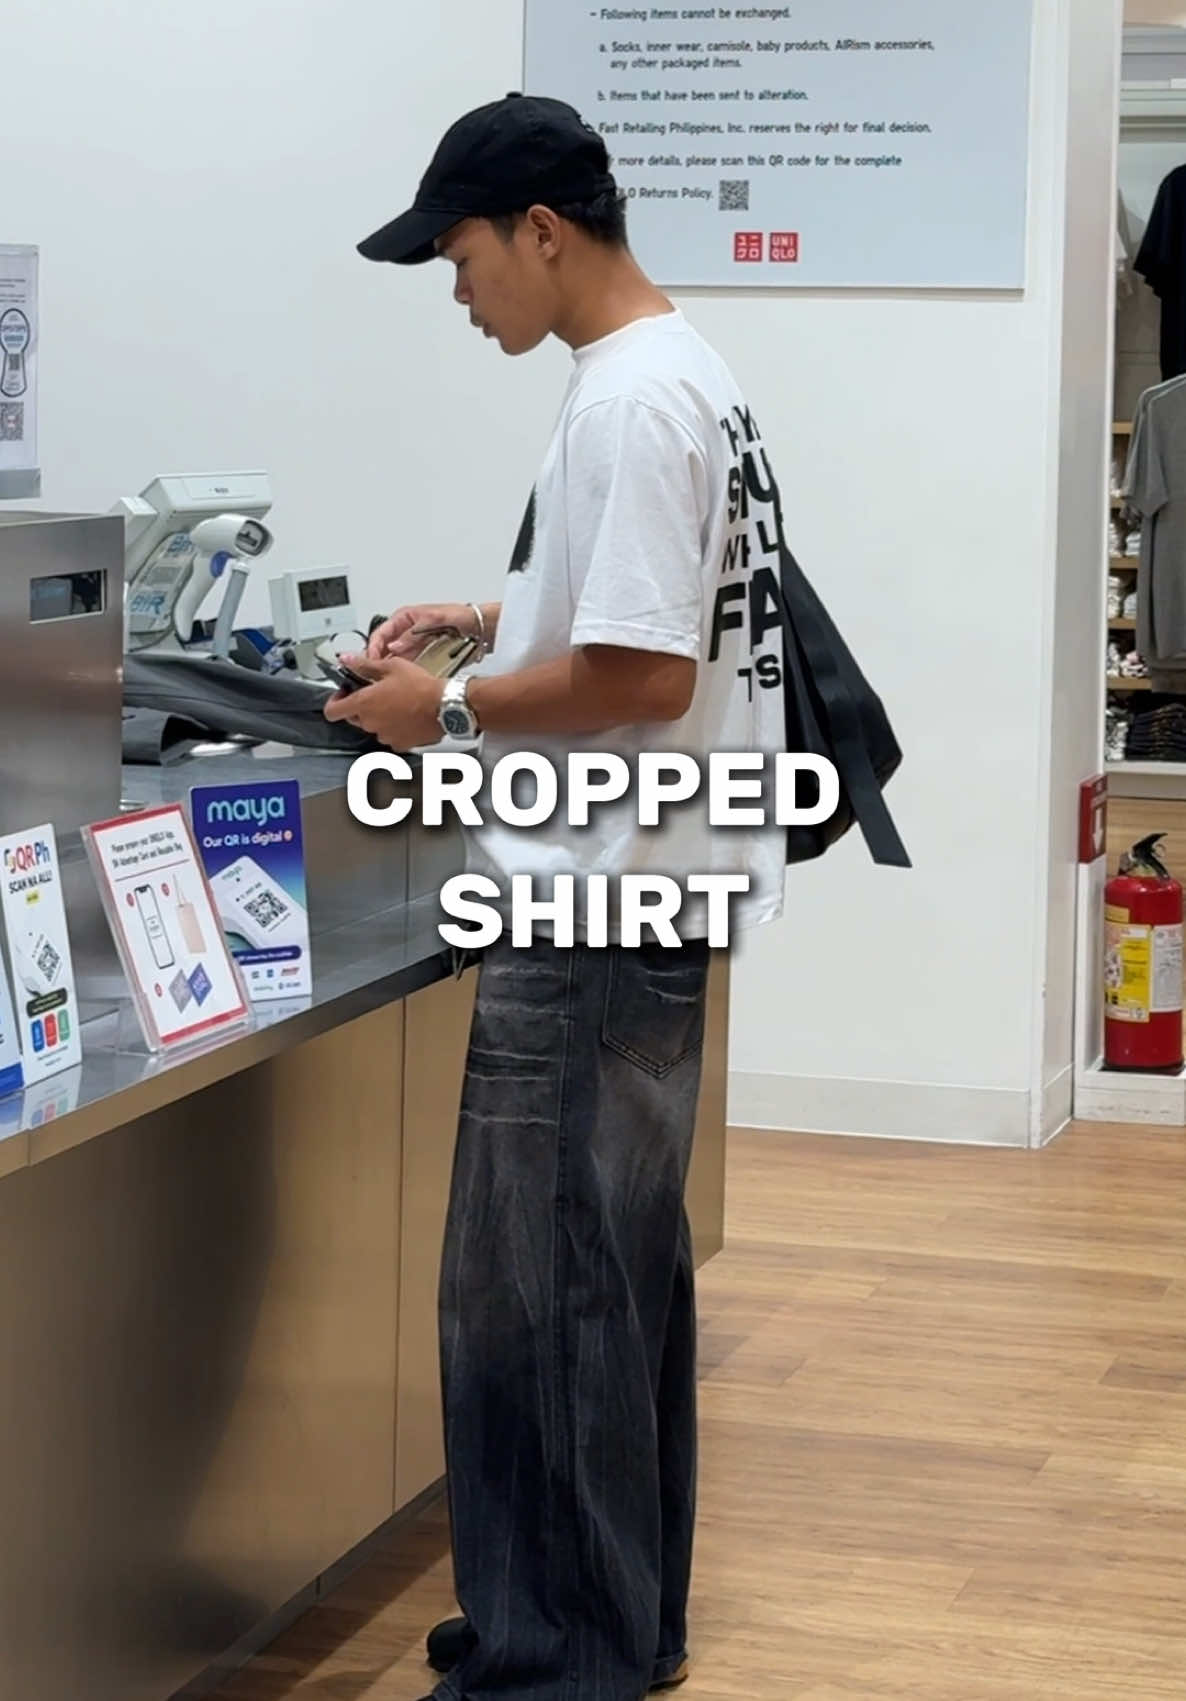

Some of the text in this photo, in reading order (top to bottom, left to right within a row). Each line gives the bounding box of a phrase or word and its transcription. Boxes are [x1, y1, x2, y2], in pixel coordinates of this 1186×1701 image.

[601, 9, 647, 21] Following
[650, 9, 678, 19] items
[681, 8, 715, 19] cannot
[647, 43, 672, 51] inner
[757, 40, 781, 53] baby
[610, 61, 628, 70] any
[632, 58, 658, 68] other
[662, 58, 709, 70] packaged
[610, 91, 637, 101] Items
[641, 90, 661, 100] that
[665, 91, 688, 101] have
[691, 90, 715, 101] been
[719, 90, 740, 100] sent
[598, 121, 621, 134] Fast
[623, 122, 666, 136] Retailing
[749, 125, 791, 133] reserves
[795, 123, 812, 133] the
[815, 122, 839, 135] right
[844, 122, 858, 133] for
[863, 122, 885, 133] final
[618, 158, 645, 166] more
[686, 155, 717, 167] please
[721, 158, 744, 166] scan
[748, 156, 765, 165] this
[787, 156, 811, 166] code
[815, 155, 830, 166] for
[834, 156, 851, 165] the
[854, 155, 902, 168] complete
[639, 187, 678, 198] Returns
[207, 796, 285, 827] maya
[202, 830, 283, 849] Our QR is digital
